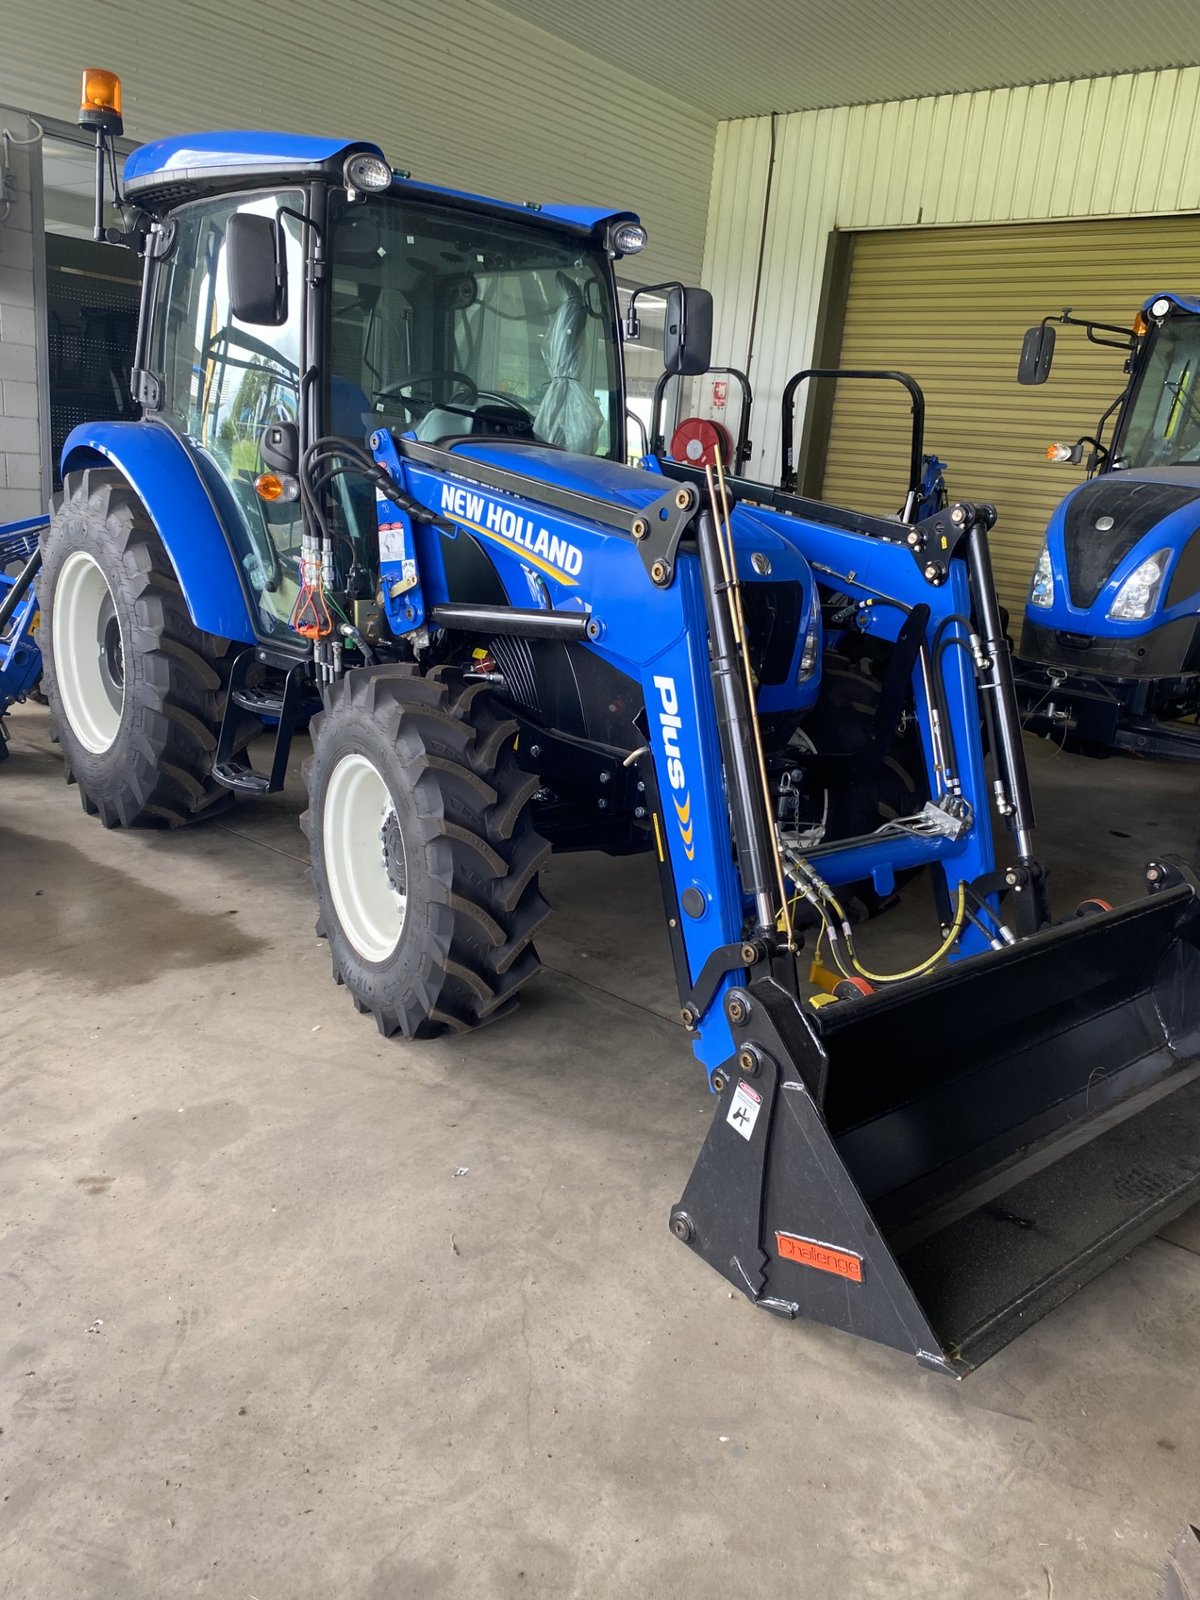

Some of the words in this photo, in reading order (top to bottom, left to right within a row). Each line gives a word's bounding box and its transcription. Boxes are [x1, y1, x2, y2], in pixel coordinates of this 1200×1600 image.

[440, 483, 485, 523] NEW
[485, 502, 583, 577] HOLLAND
[653, 675, 686, 790] Plus
[779, 1238, 860, 1274] Challenge
